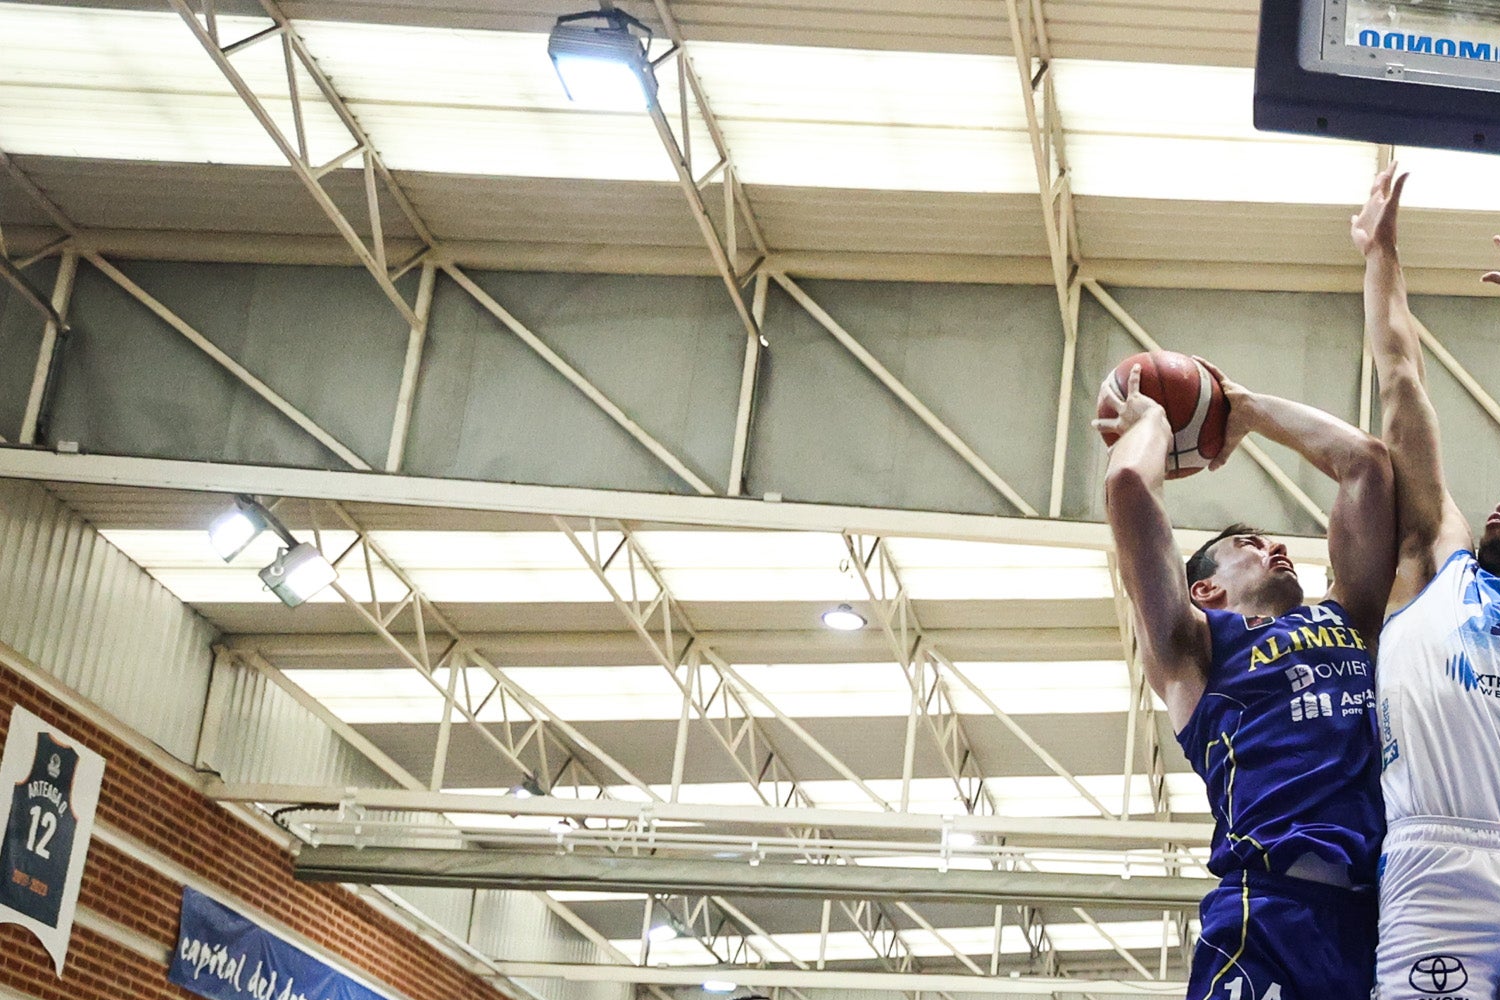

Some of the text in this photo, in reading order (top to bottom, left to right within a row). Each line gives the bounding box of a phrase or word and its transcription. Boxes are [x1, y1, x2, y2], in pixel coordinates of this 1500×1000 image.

[28, 780, 63, 808] ARTEAGA
[26, 805, 57, 860] 12
[181, 937, 247, 992] capital
